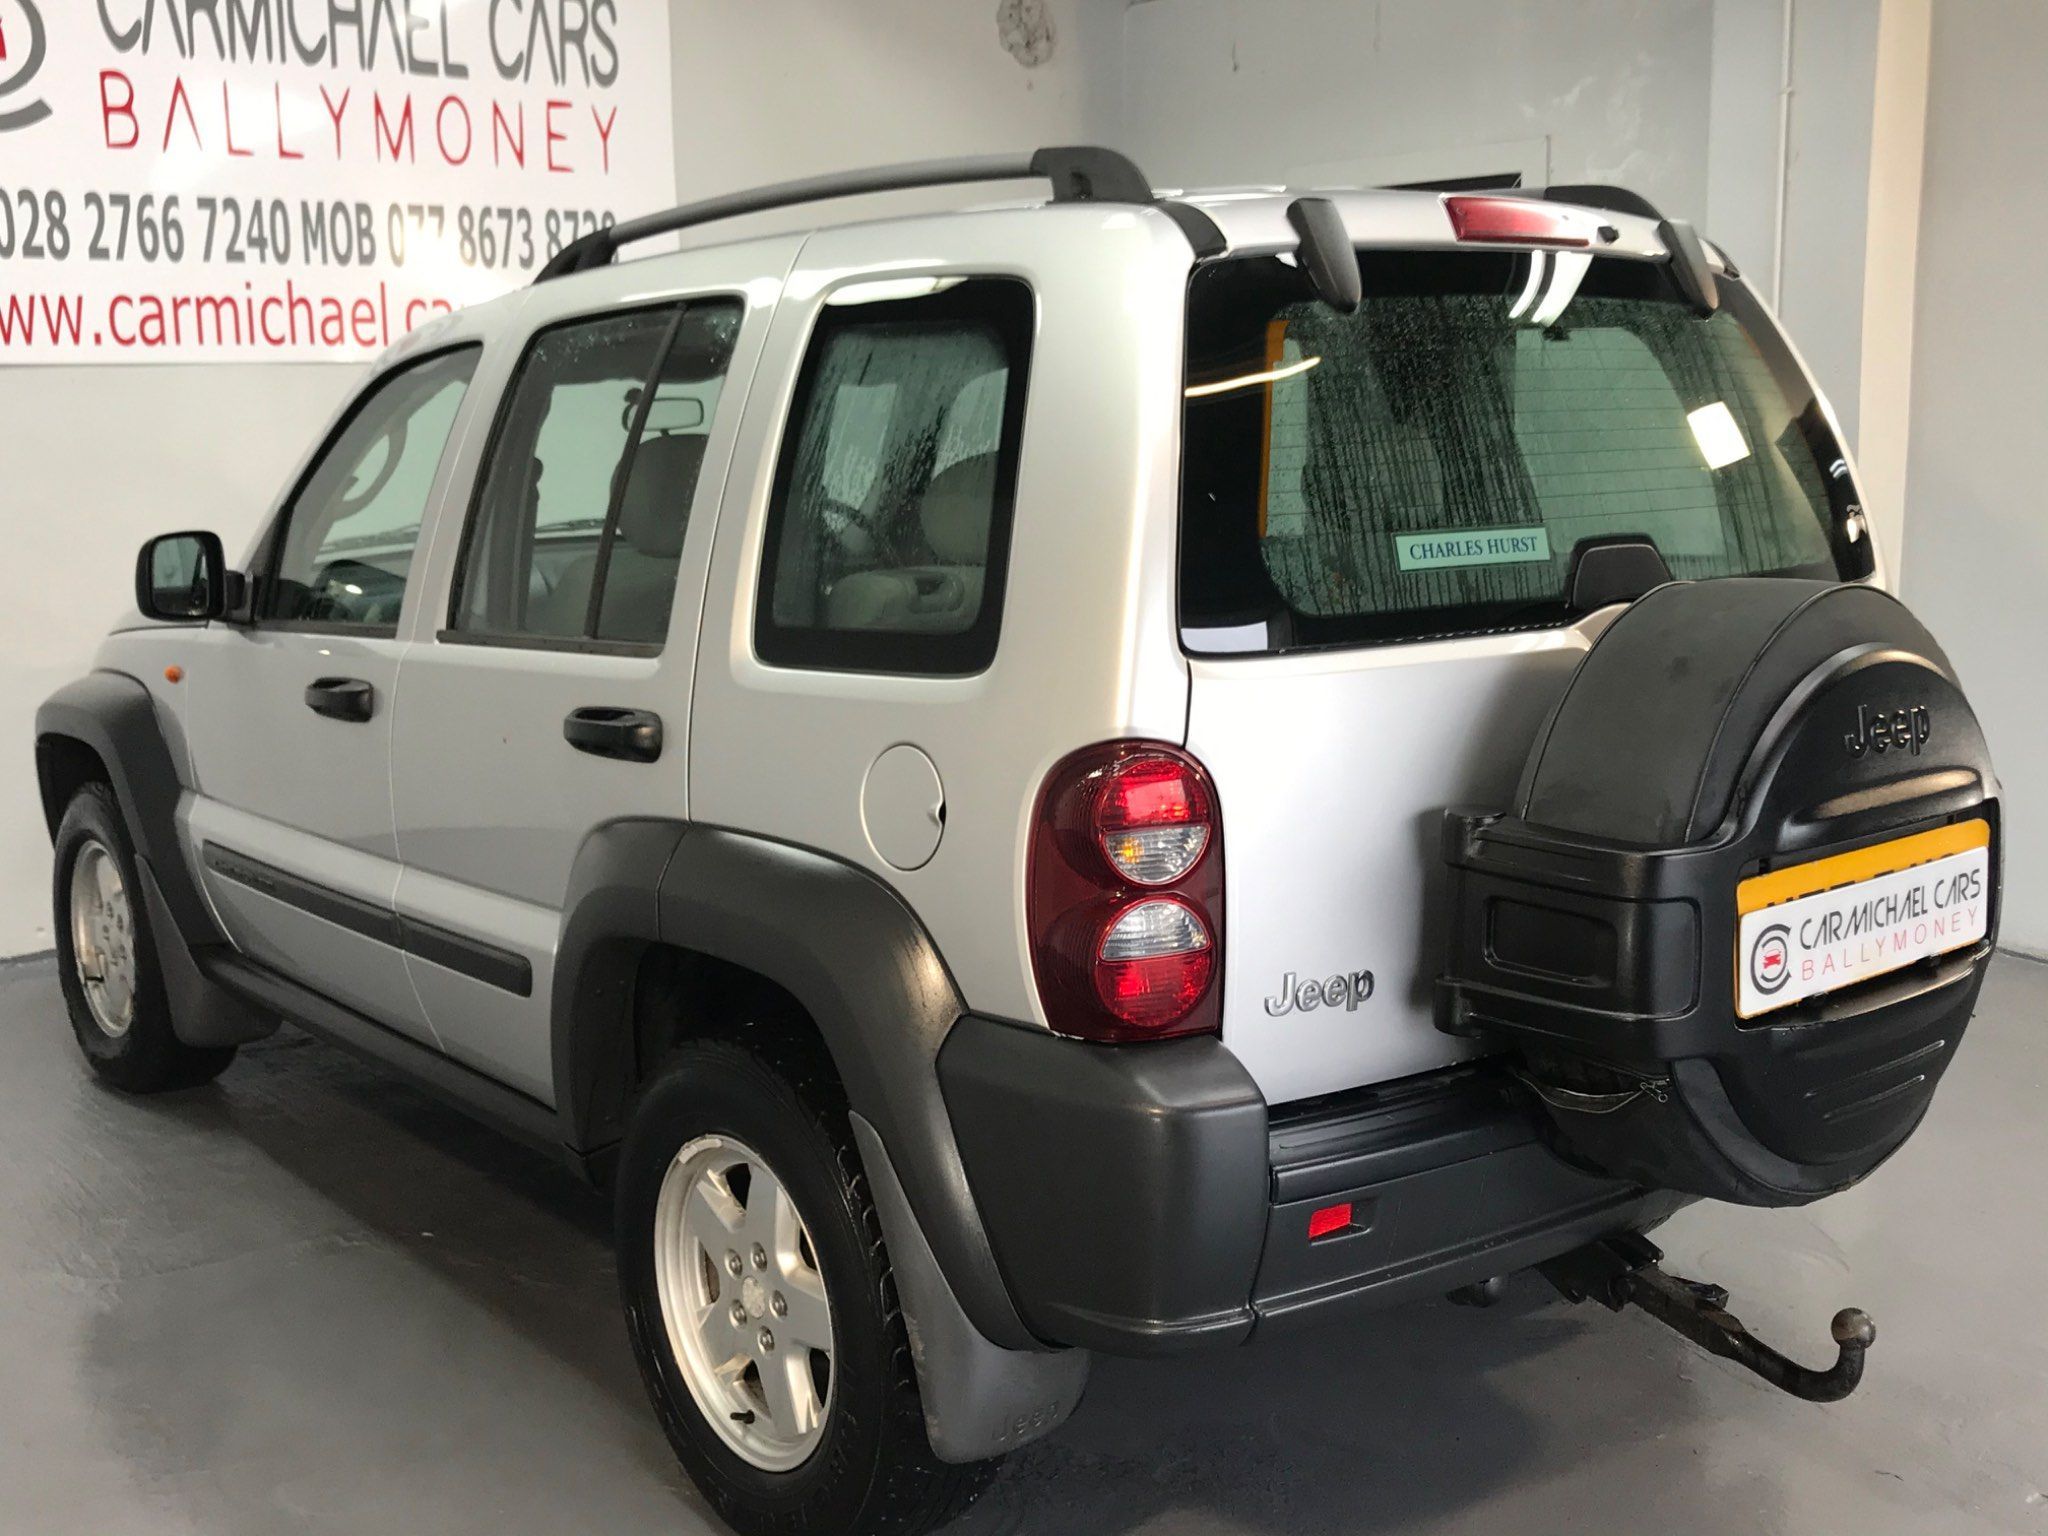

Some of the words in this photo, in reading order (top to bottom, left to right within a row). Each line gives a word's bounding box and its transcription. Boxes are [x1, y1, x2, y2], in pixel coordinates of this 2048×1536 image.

[96, 0, 469, 80] CARMICHAEL
[488, 0, 619, 89] CARS
[99, 68, 618, 176] BALLYMONEY
[84, 190, 185, 264] 2766
[196, 195, 291, 265] 7240
[302, 200, 377, 266] MOB
[458, 204, 535, 270] 8673
[1409, 539, 1484, 561] CHARLES
[1486, 536, 1538, 554] HURST
[1844, 704, 1931, 757] Jeep
[1800, 885, 1928, 950] CARMICHAEL
[1933, 868, 1981, 909] CARS
[1801, 905, 1978, 982] BALLYMONEY
[1264, 968, 1375, 1017] Jeep
